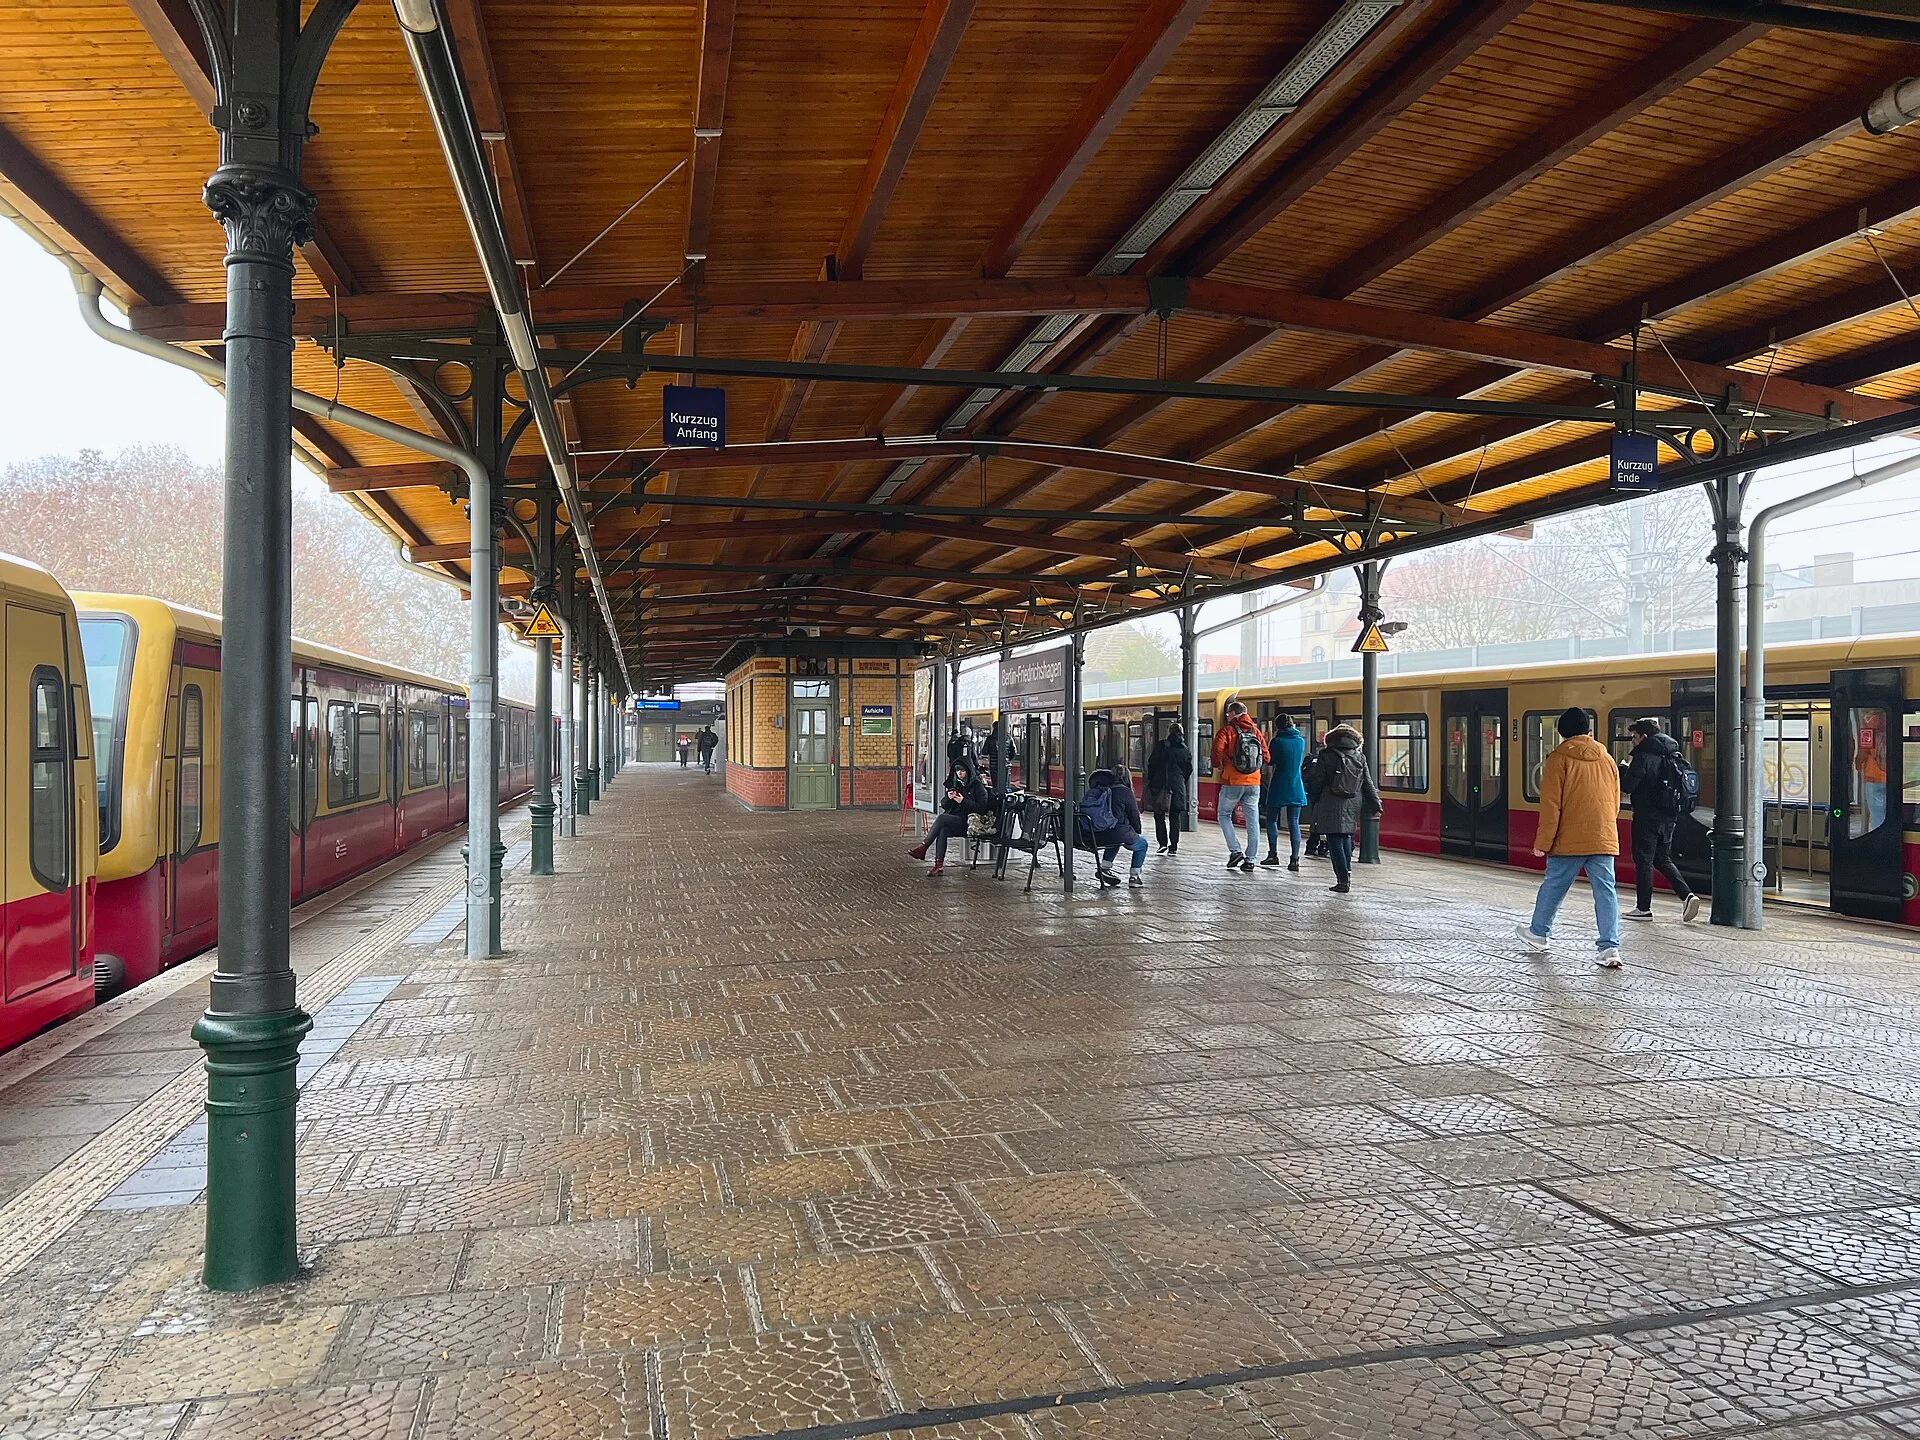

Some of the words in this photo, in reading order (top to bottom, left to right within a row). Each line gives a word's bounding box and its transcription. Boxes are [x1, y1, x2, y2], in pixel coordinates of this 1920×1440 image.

[670, 412, 718, 428] Kurzzug
[676, 427, 718, 442] Anfang
[1617, 459, 1653, 473] Kurzzug
[1617, 472, 1640, 483] Ende
[1001, 660, 1062, 687] Berlin-Friedrichshagen
